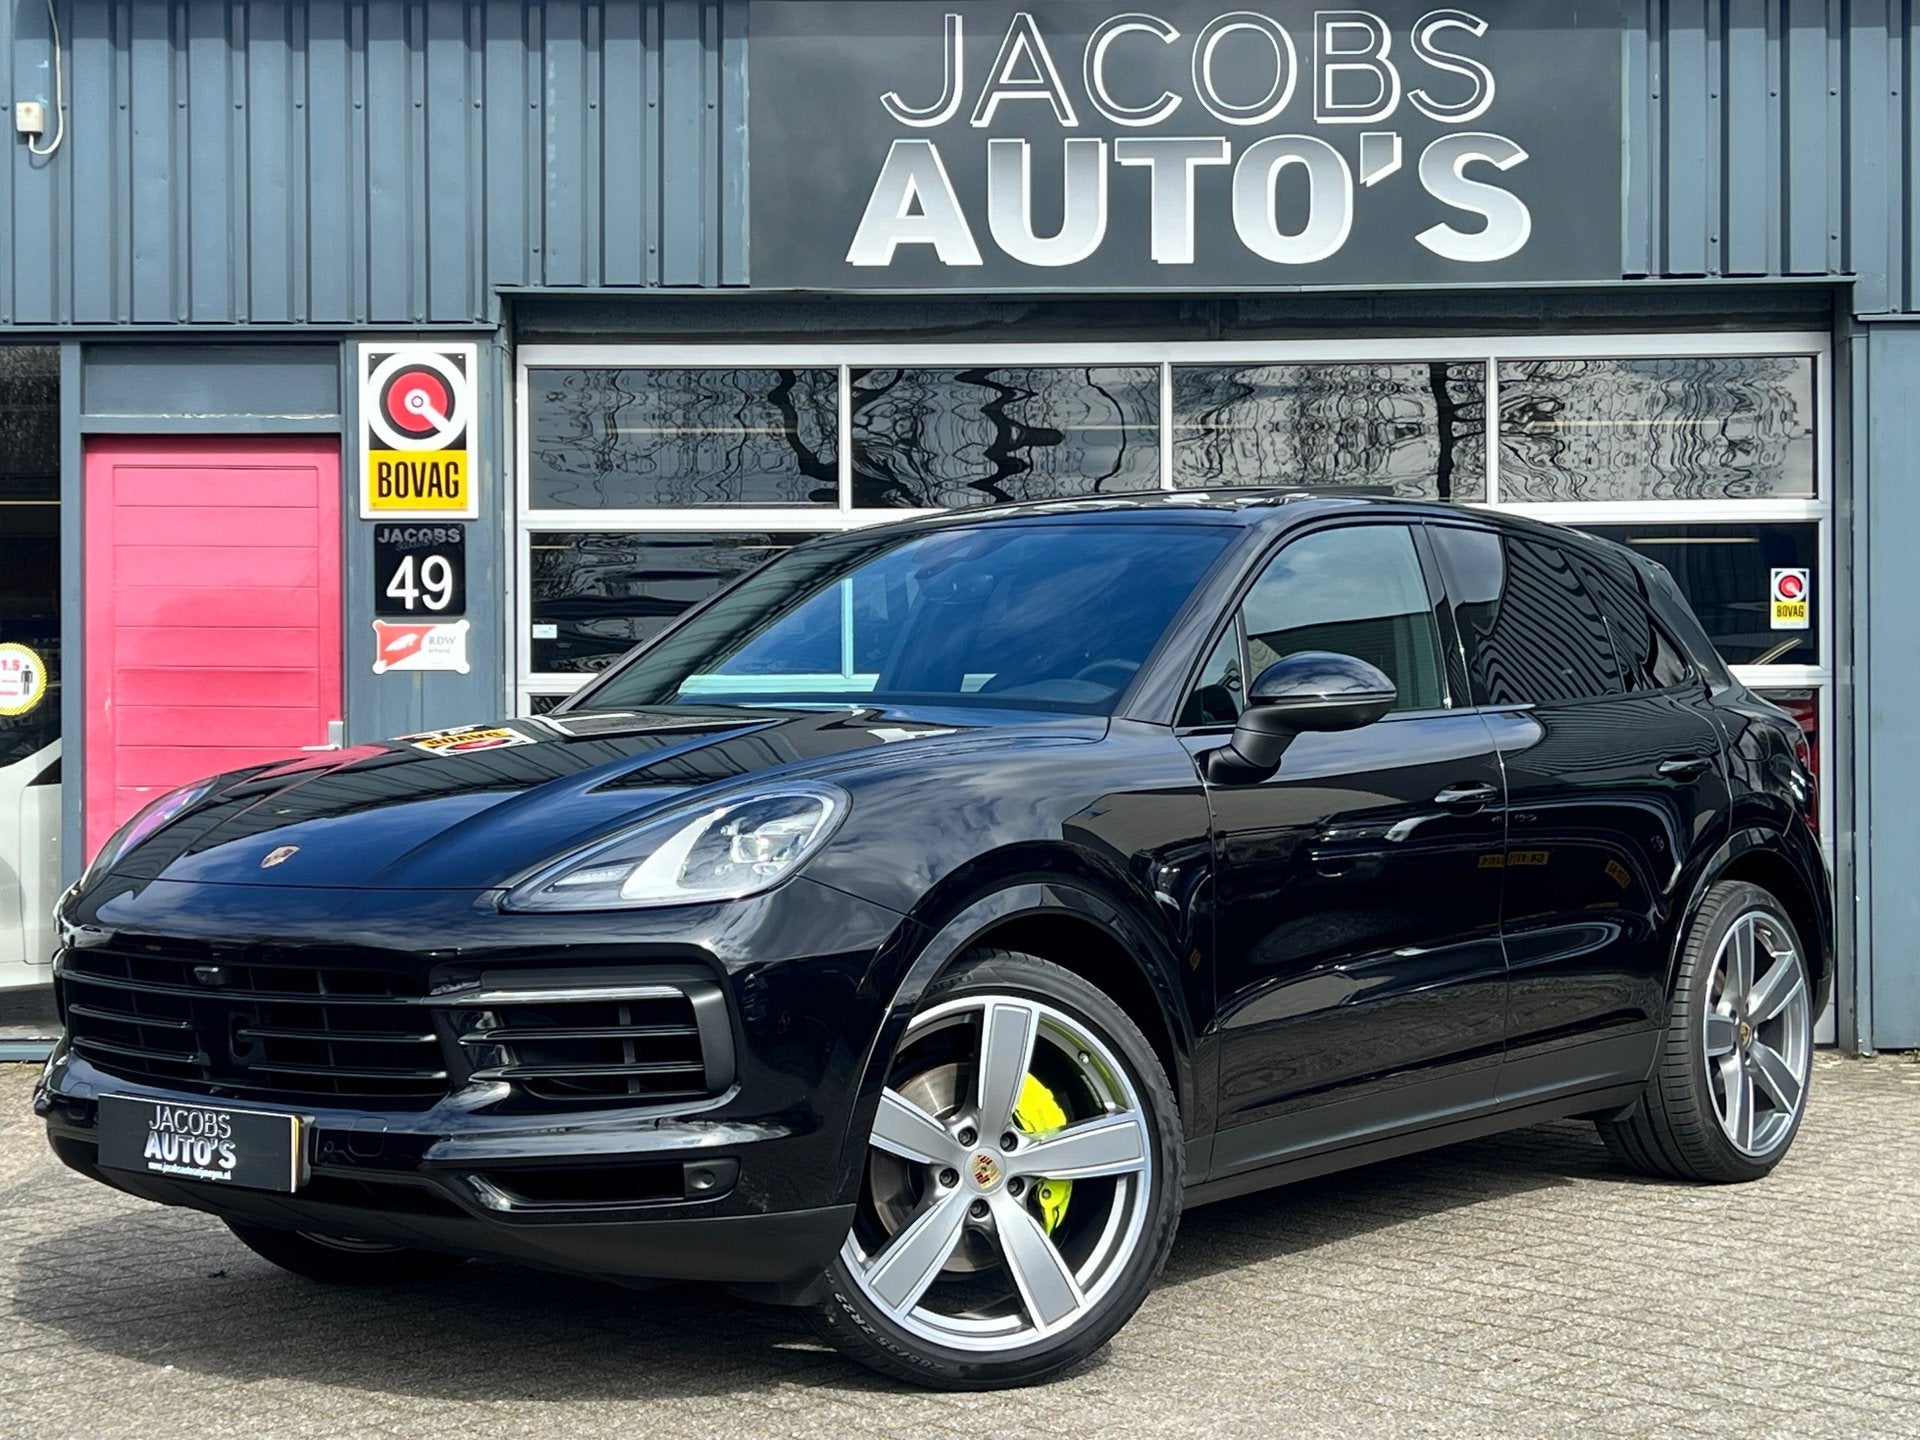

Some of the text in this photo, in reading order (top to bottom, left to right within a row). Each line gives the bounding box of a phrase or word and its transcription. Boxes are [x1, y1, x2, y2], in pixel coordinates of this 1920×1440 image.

[880, 9, 1495, 127] JACOBS
[846, 132, 1531, 266] AUTO'S
[378, 461, 459, 498] BOVAG
[377, 528, 461, 543] JACOBS
[386, 555, 452, 610] 49
[1777, 605, 1804, 617] BOVAG
[429, 636, 456, 645] RDW
[149, 1105, 232, 1138] JACOBS
[144, 1132, 237, 1169] AUTO'S
